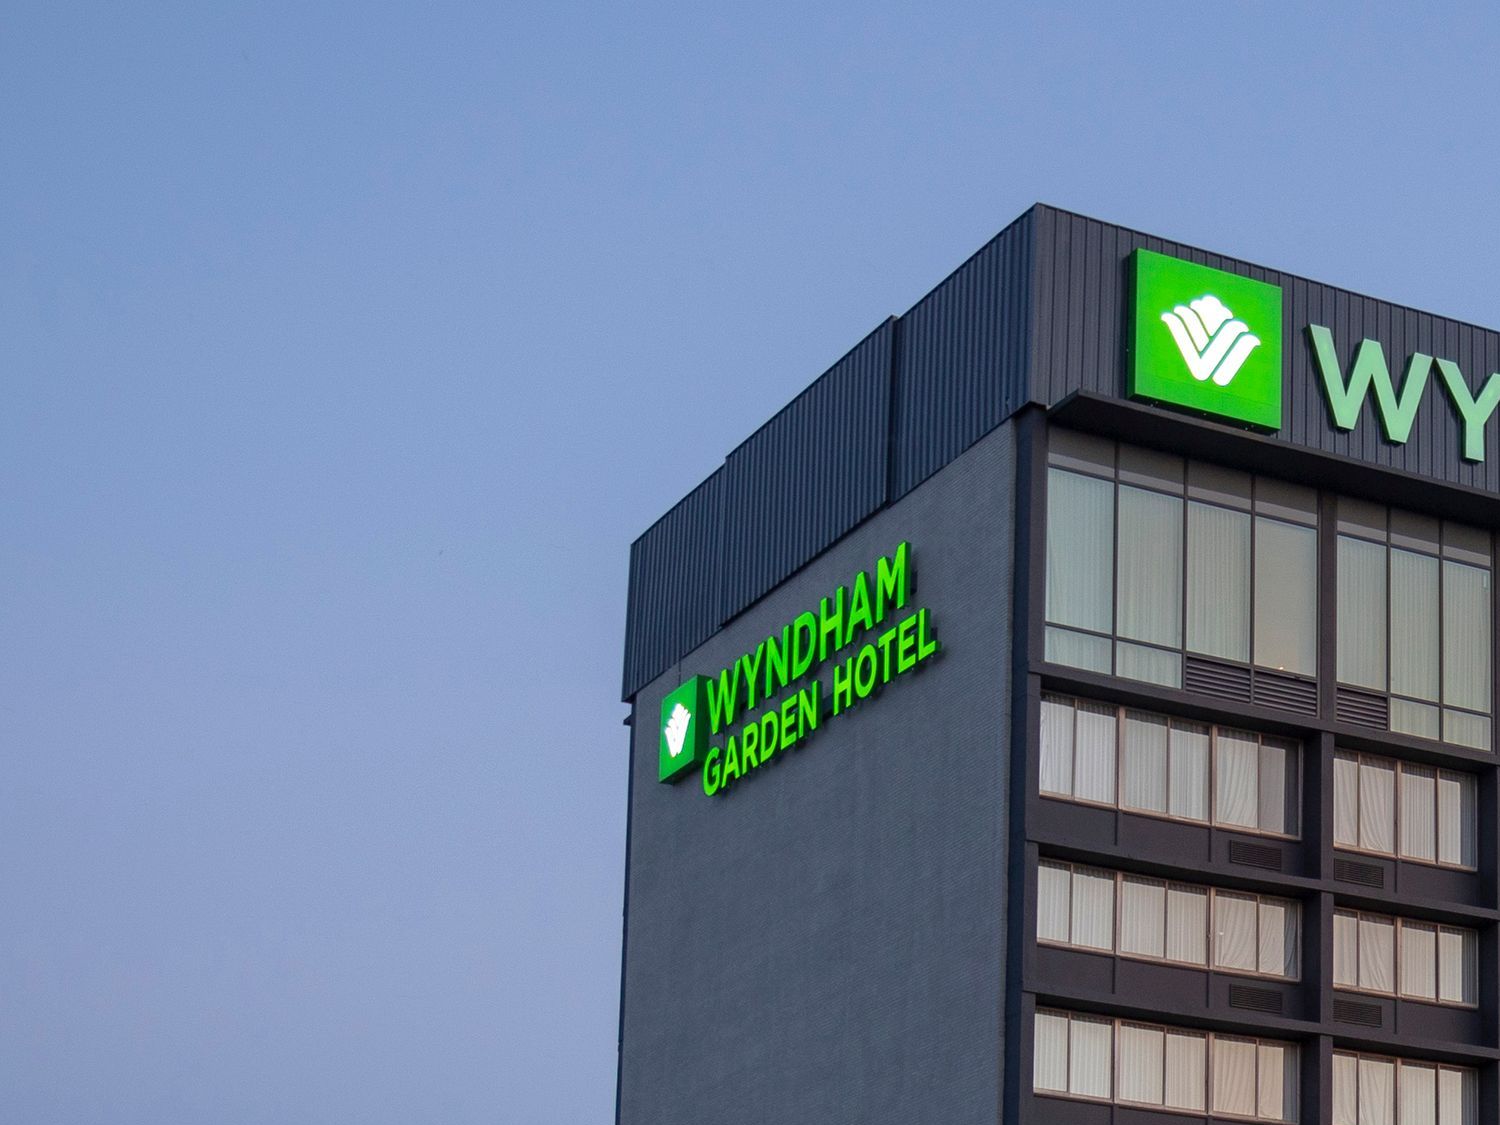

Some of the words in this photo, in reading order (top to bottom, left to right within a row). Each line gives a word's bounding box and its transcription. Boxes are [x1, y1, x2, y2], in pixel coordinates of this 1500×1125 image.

[702, 679, 822, 797] GARDEN
[832, 606, 938, 717] HOTEL
[706, 540, 911, 736] WYNDHAM
